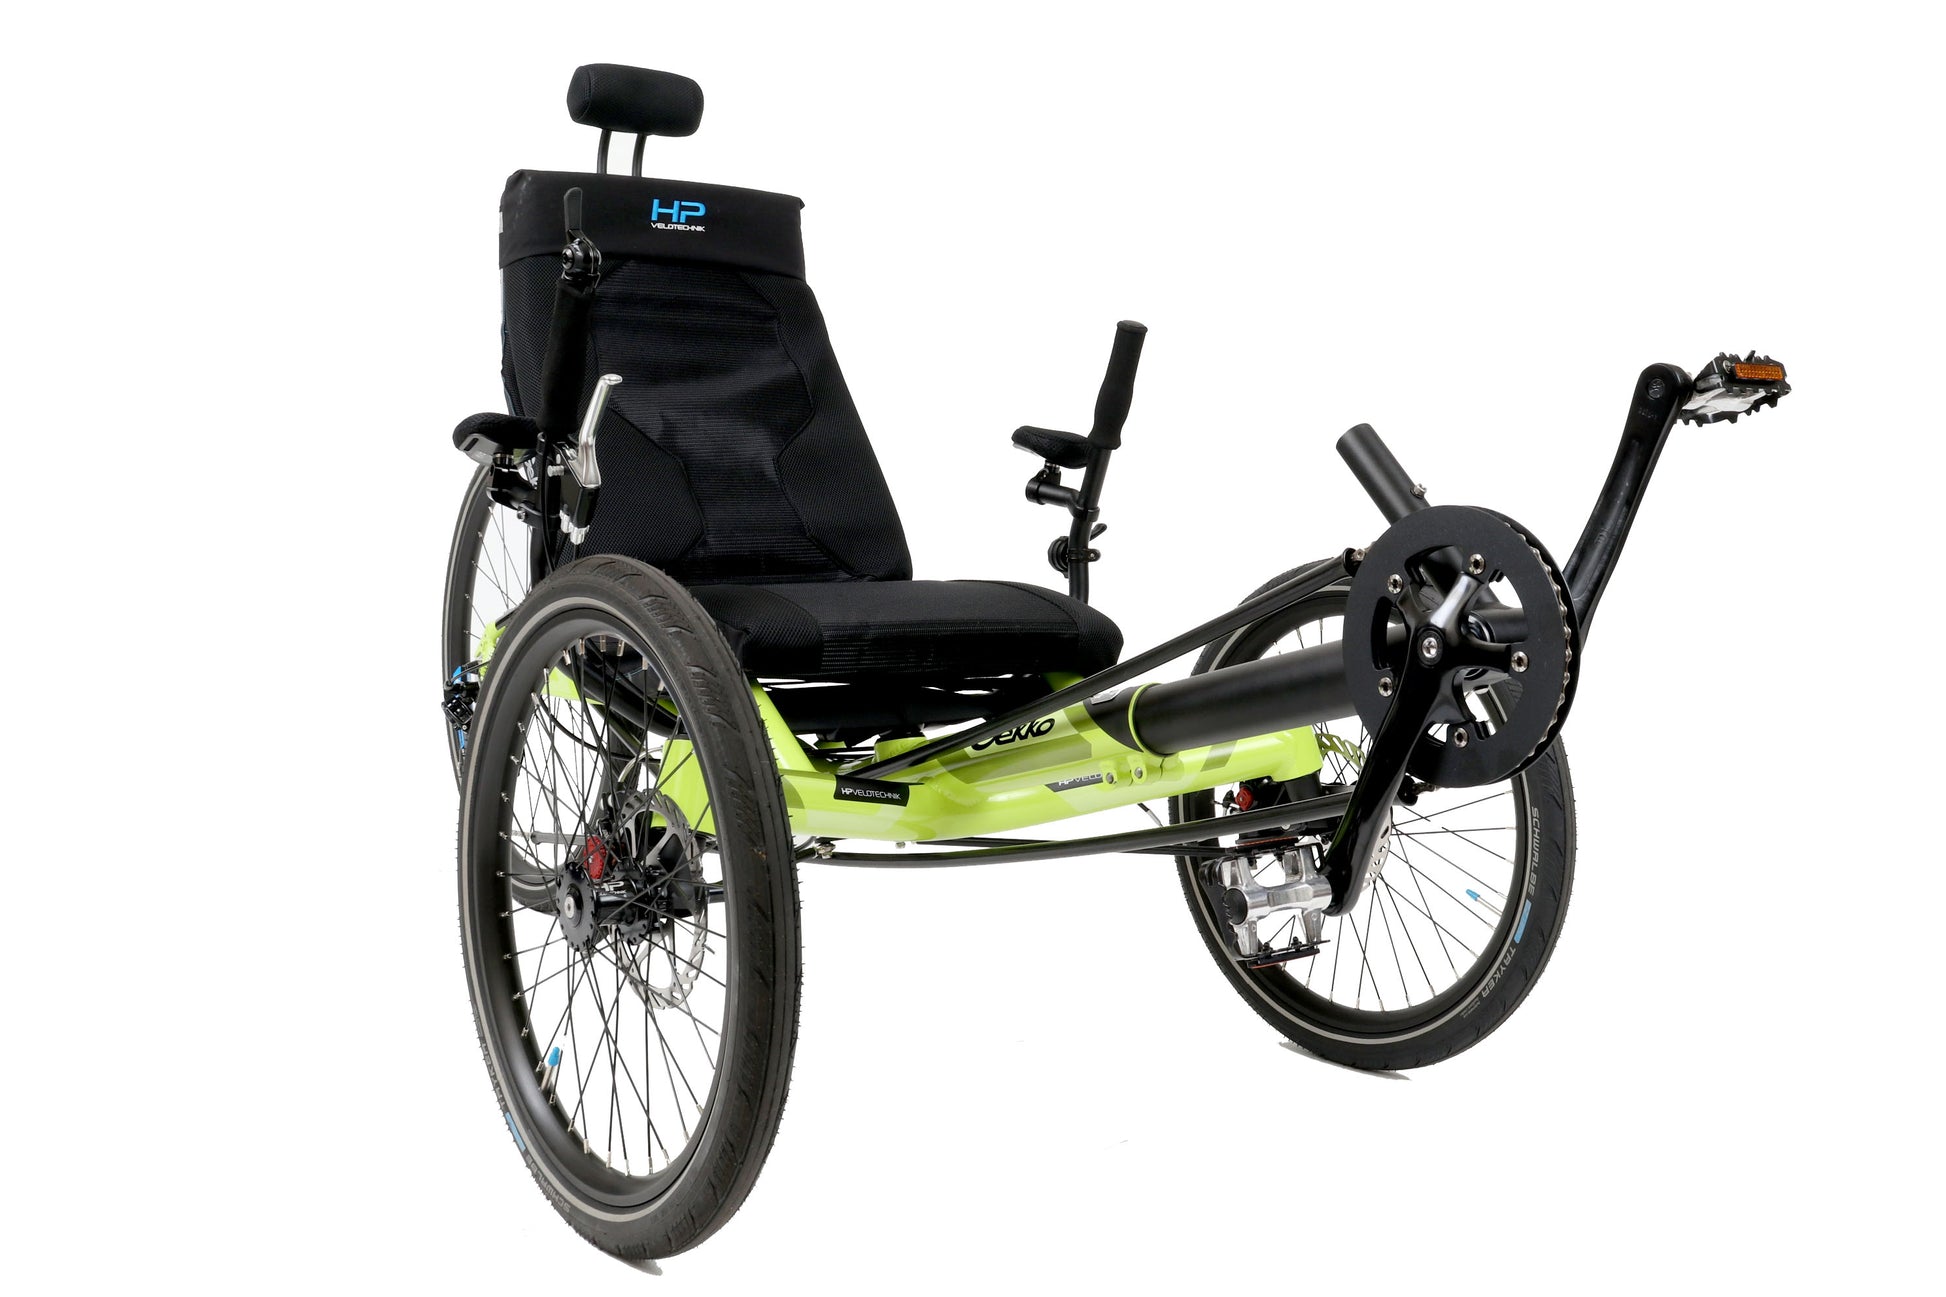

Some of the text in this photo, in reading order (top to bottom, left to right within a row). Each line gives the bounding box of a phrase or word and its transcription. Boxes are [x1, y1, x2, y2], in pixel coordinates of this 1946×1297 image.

[650, 222, 706, 232] VELOTECHNIK
[651, 198, 706, 223] HP
[1528, 806, 1541, 897] SCHWALBE
[1481, 946, 1516, 998] TRYKER
[524, 1154, 571, 1213] SCHWALBE
